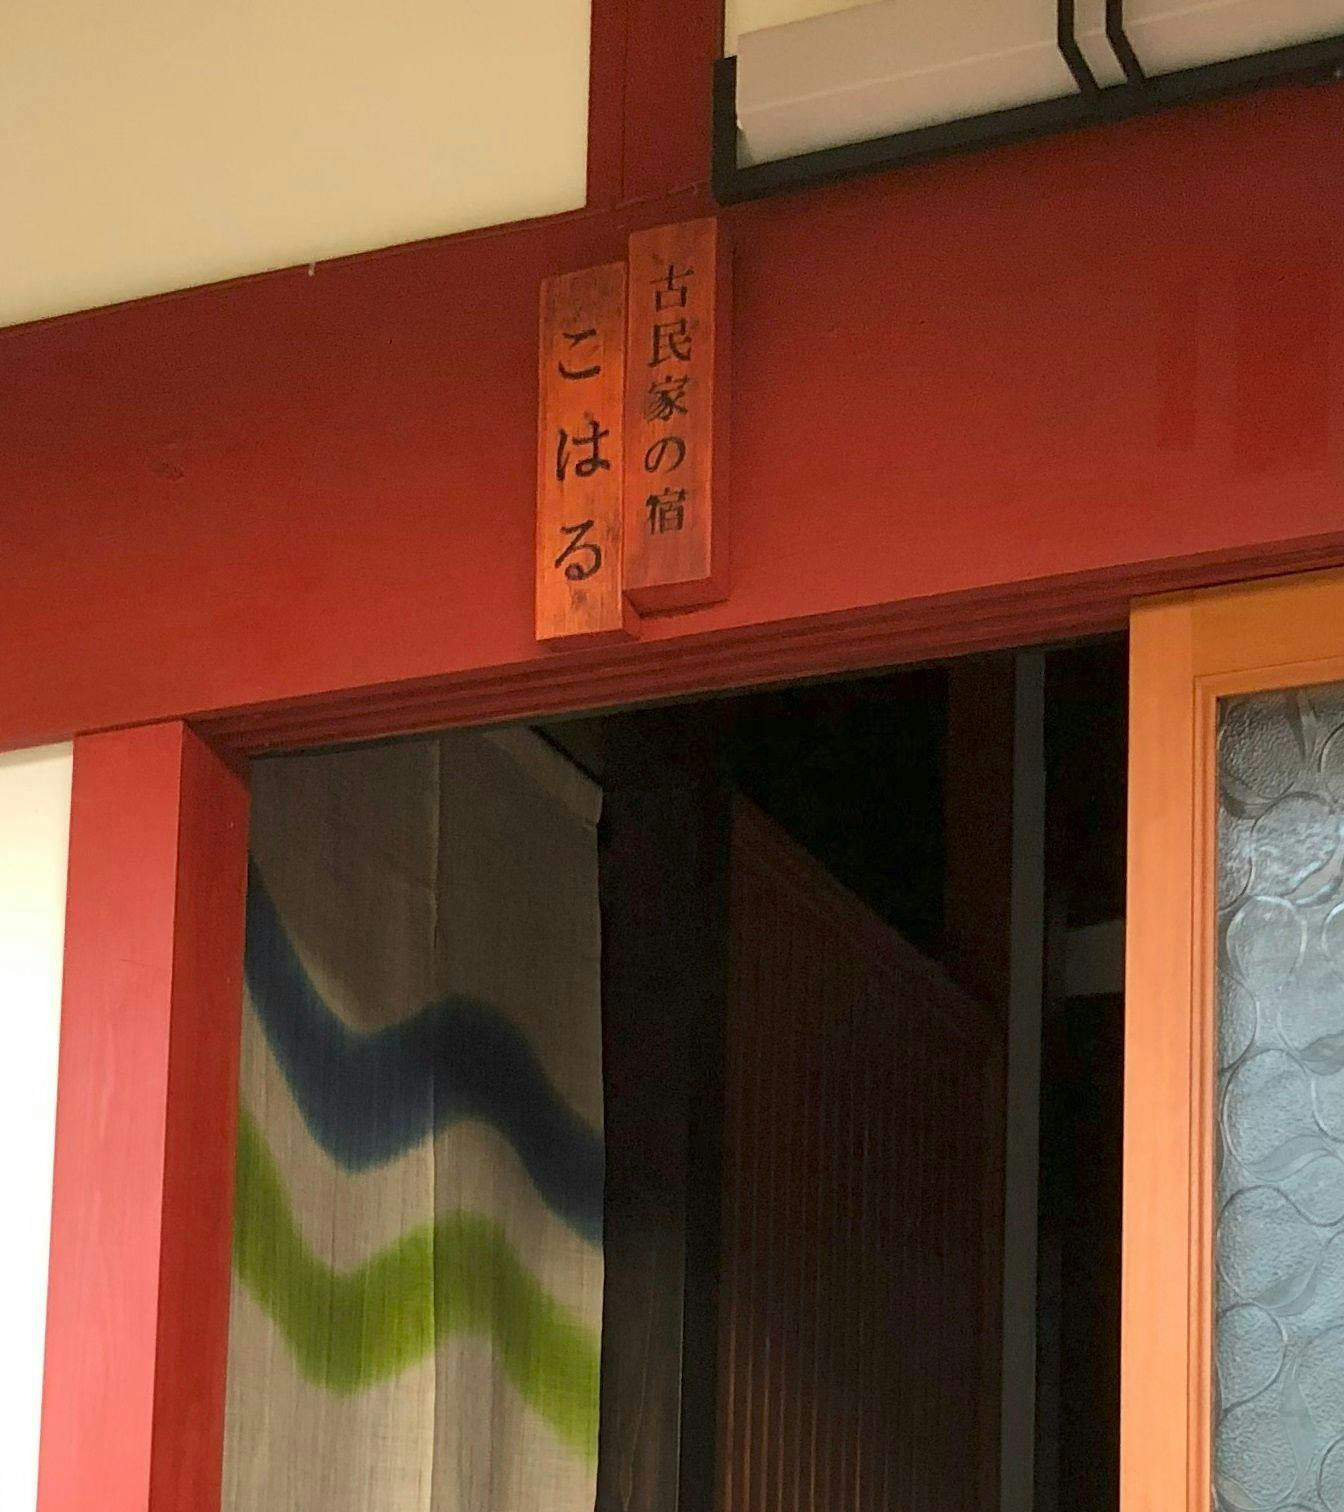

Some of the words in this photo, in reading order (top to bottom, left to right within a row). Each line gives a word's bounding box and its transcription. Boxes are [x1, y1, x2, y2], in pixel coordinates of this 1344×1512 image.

[554, 327, 611, 581] こはる
[643, 263, 695, 536] 古民家の宿
